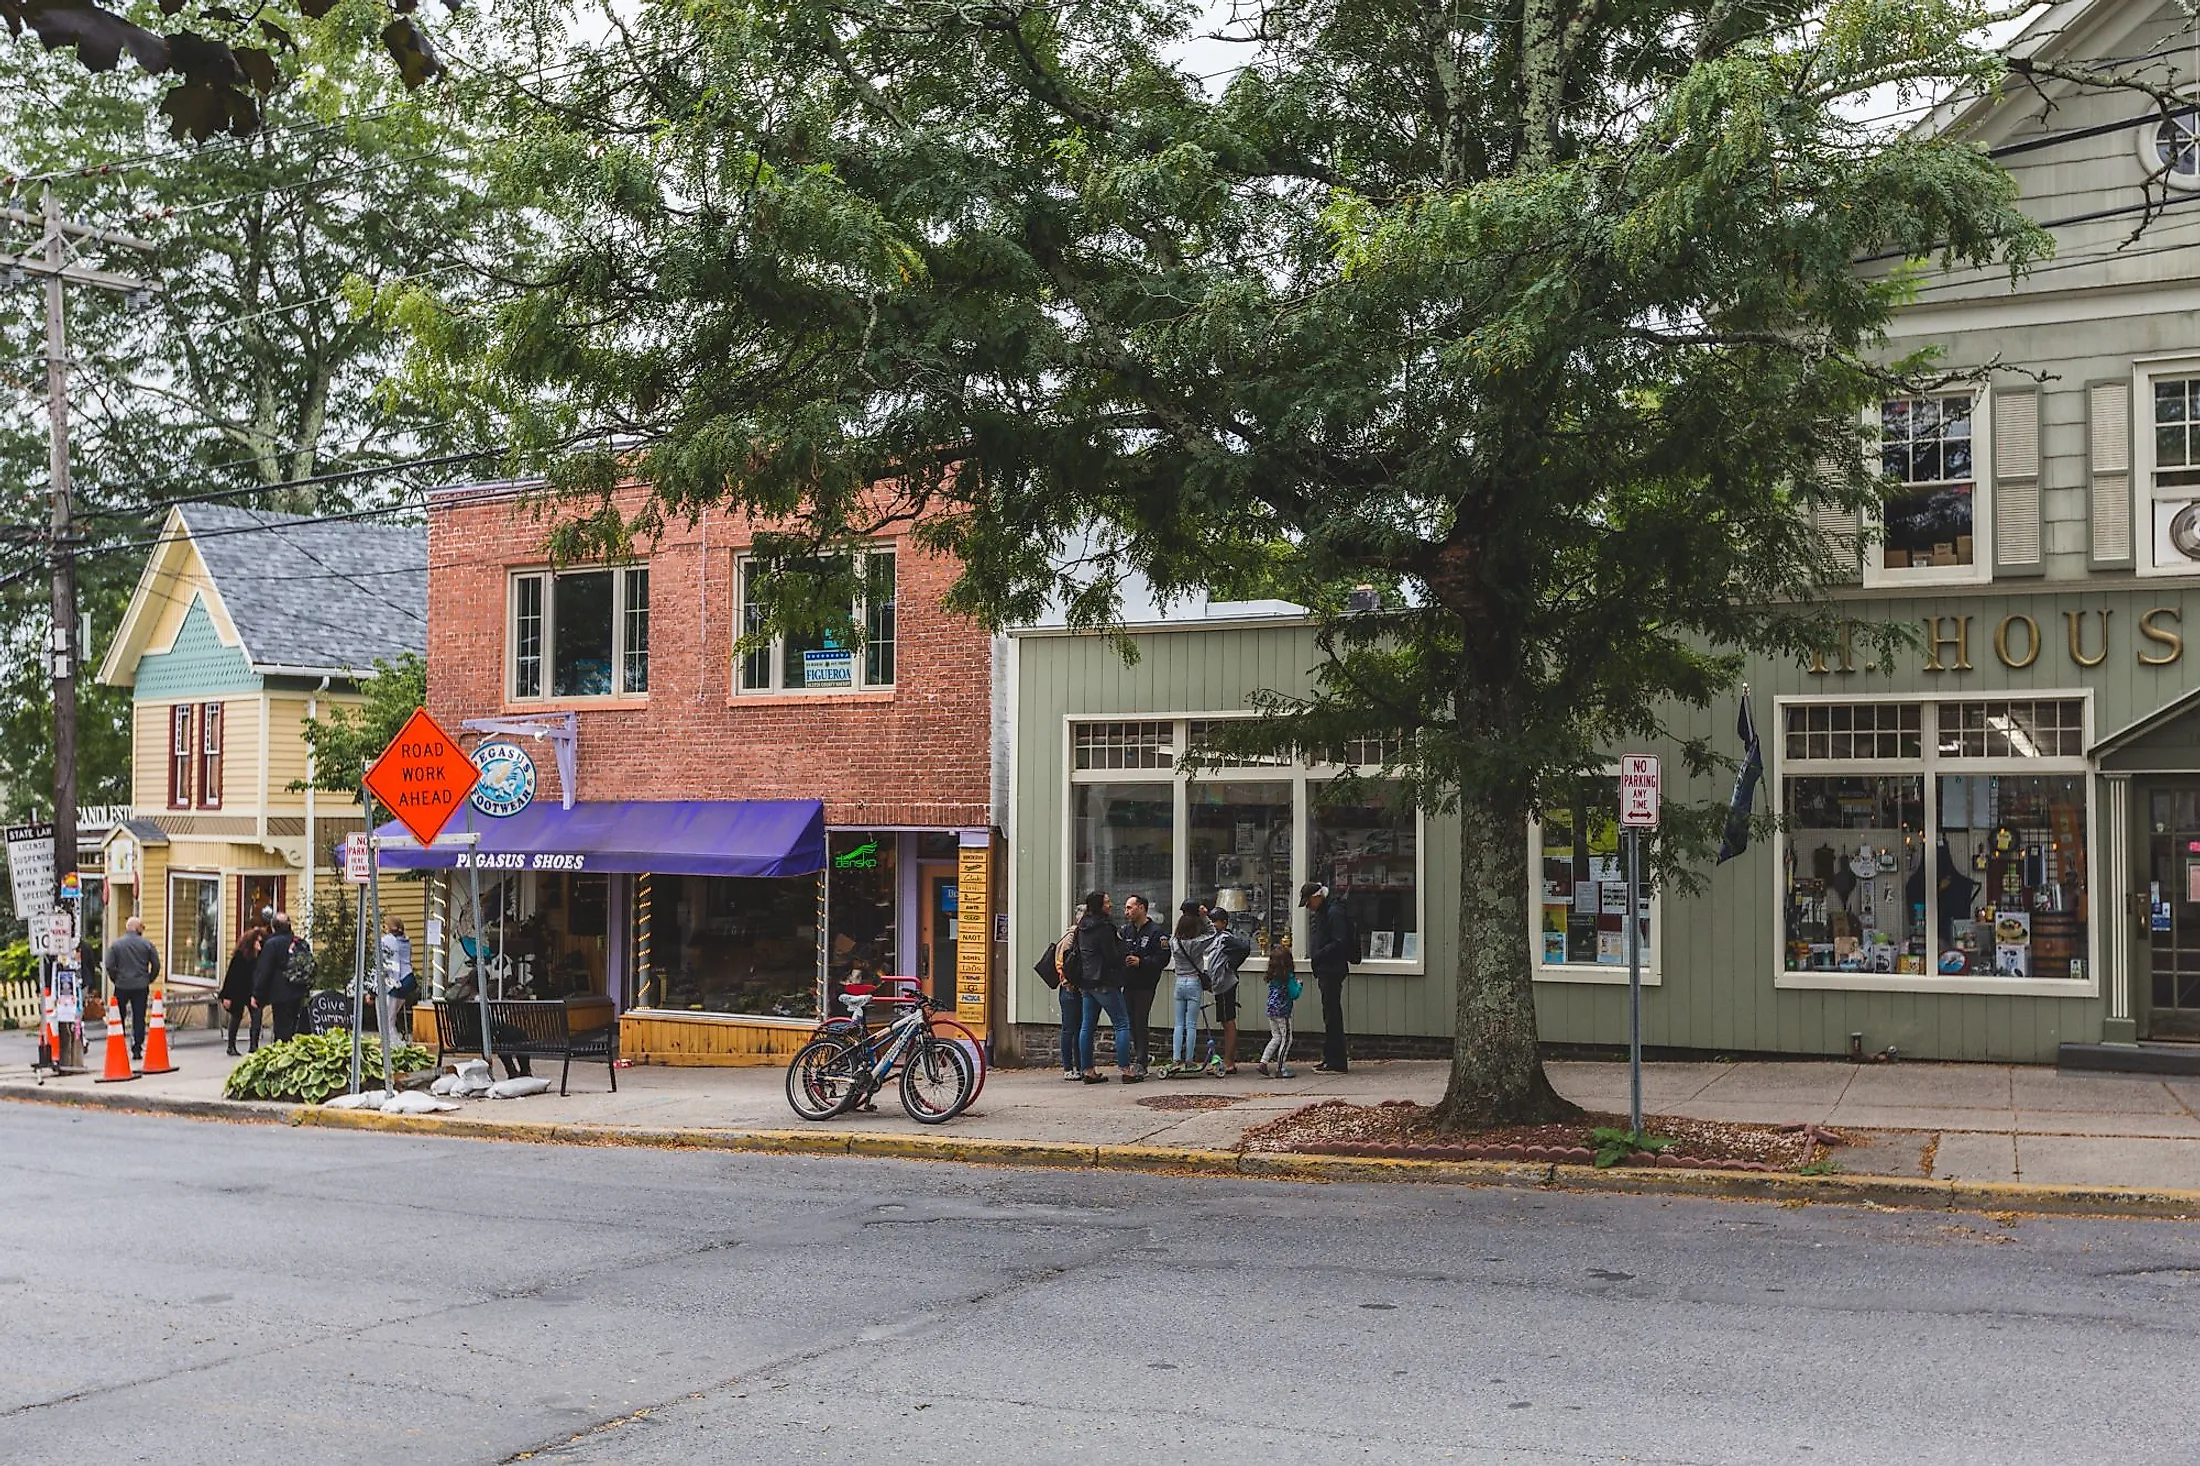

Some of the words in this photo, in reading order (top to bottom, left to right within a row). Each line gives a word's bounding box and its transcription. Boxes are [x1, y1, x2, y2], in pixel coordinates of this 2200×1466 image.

[1923, 606, 2183, 672] HOUS
[806, 669, 851, 680] FIGUEROA
[401, 742, 444, 758] ROAD
[1633, 760, 1647, 773] NO
[402, 766, 446, 782] WORK
[1624, 775, 1656, 788] PARKING
[399, 789, 452, 807] AHEAD
[470, 788, 531, 814] FOOTWEAR
[1632, 789, 1647, 799] ANY
[1632, 799, 1648, 810] TIME
[9, 828, 34, 841] STATE
[36, 826, 53, 838] LAW
[18, 840, 47, 852] LICENSE
[356, 836, 368, 846] NO
[14, 852, 55, 866] SUSPENDED
[532, 854, 585, 869] SHOES
[835, 853, 877, 868] dansko
[16, 867, 39, 877] AFTER
[17, 878, 36, 889] WORK
[40, 877, 54, 887] ZON
[318, 996, 345, 1011] Give
